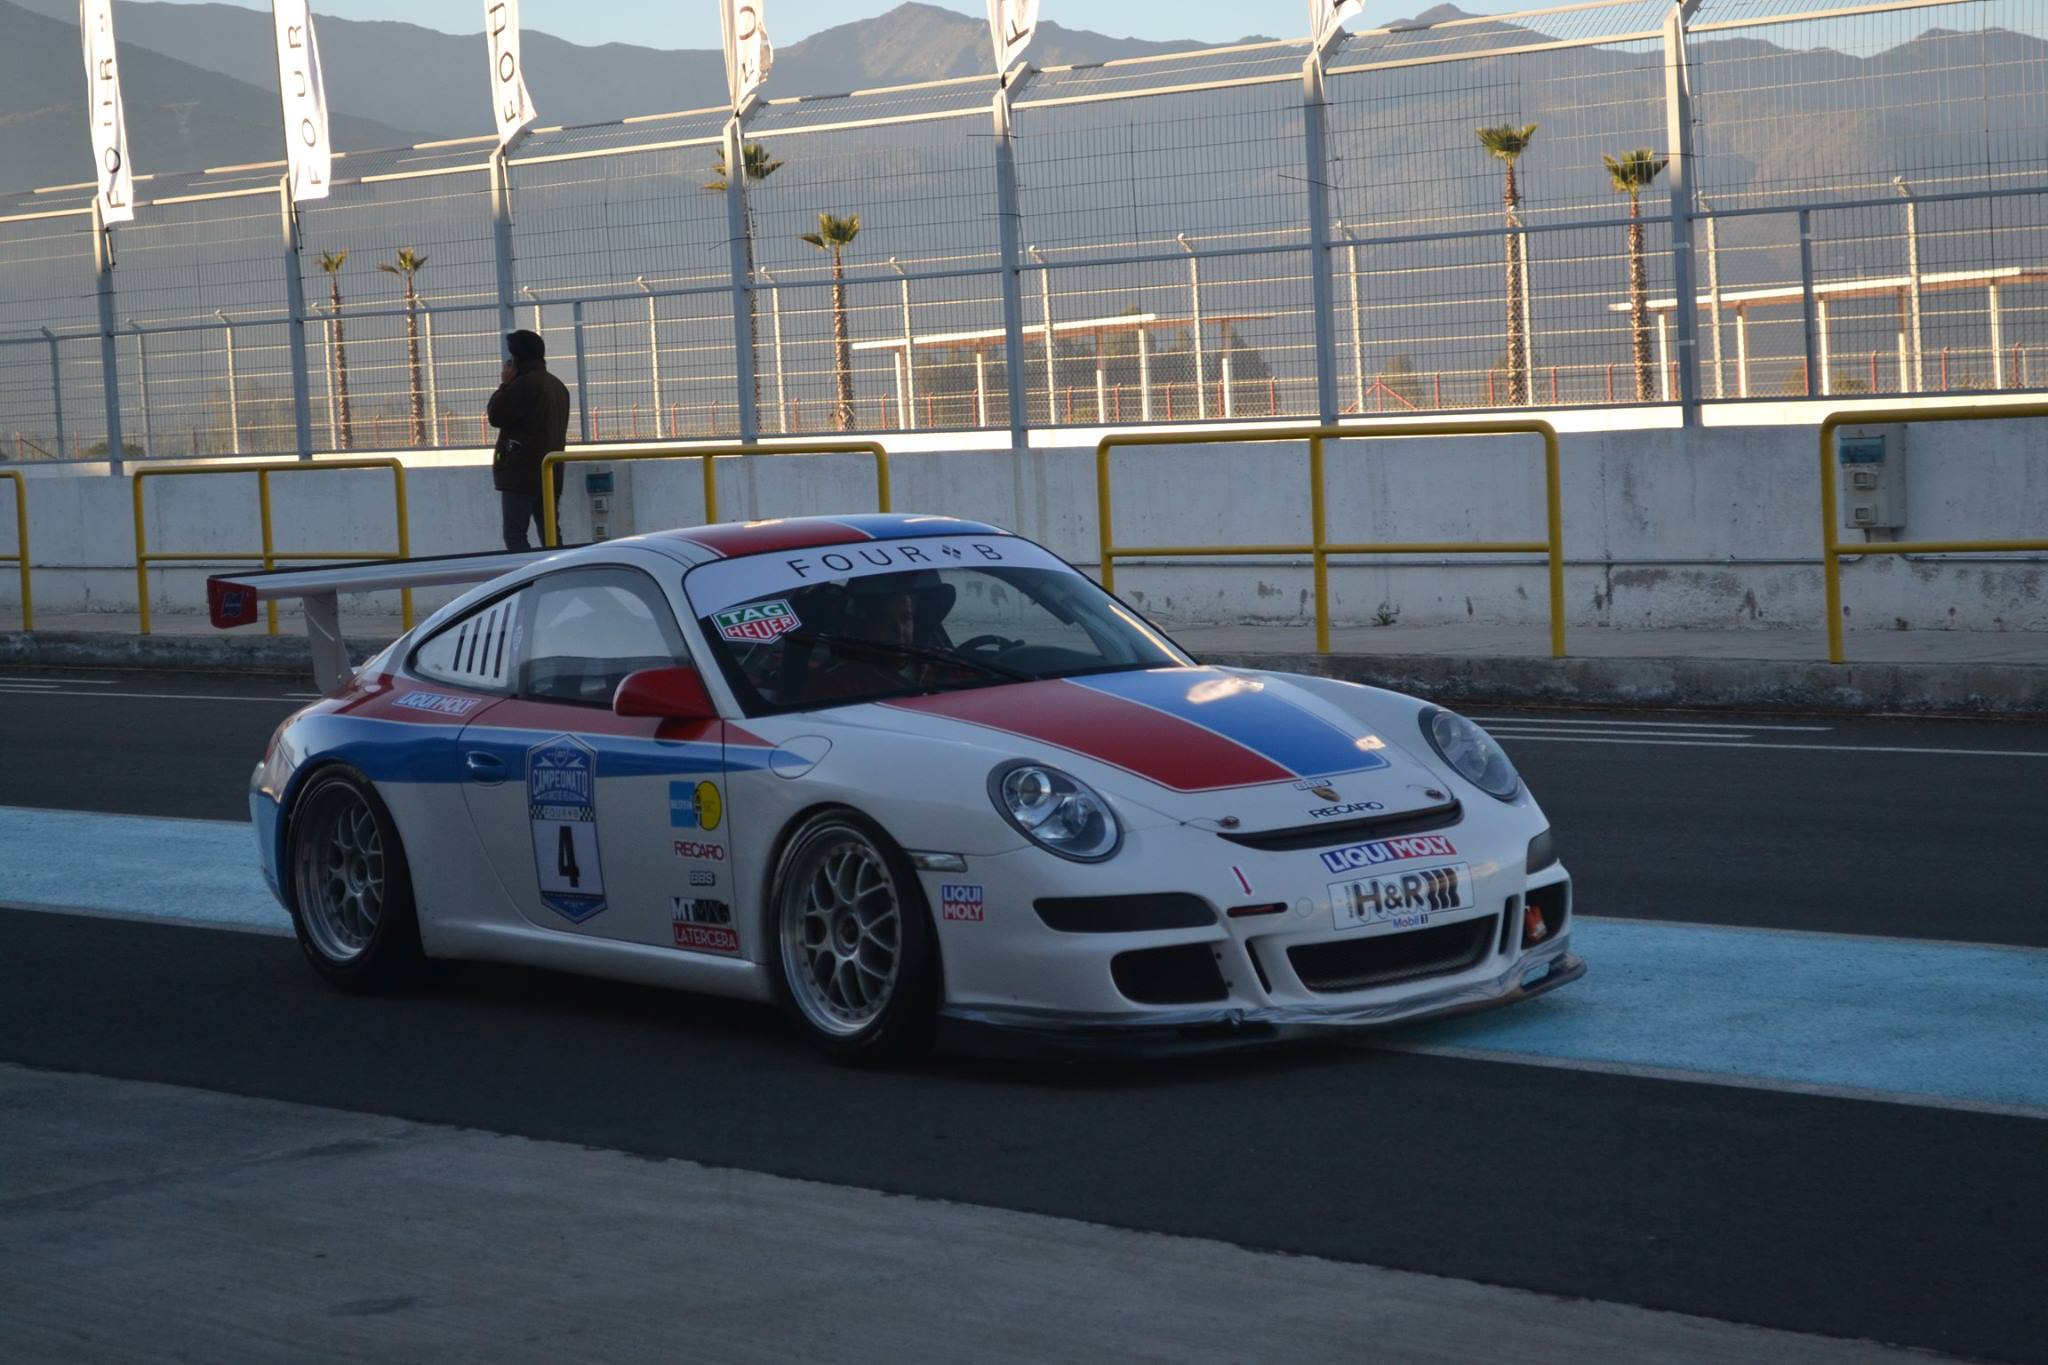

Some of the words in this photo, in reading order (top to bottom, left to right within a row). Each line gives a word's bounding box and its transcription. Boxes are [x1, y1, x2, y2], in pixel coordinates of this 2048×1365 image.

[287, 25, 322, 185] FOUR
[786, 546, 931, 578] FOUR
[972, 543, 1003, 561] B
[721, 603, 786, 625] TAG
[727, 616, 800, 640] HEUER
[532, 768, 588, 798] CAMPEONATO
[1308, 801, 1384, 819] RECARO
[558, 826, 580, 889] 4
[674, 840, 724, 860] RECARO
[1322, 842, 1393, 872] LIQUI
[1391, 836, 1453, 859] MOLY
[690, 871, 714, 885] BBS
[943, 886, 981, 902] LIQUI
[1353, 874, 1424, 917] H&R
[944, 903, 982, 920] MOLY
[1392, 914, 1420, 929] Mobil
